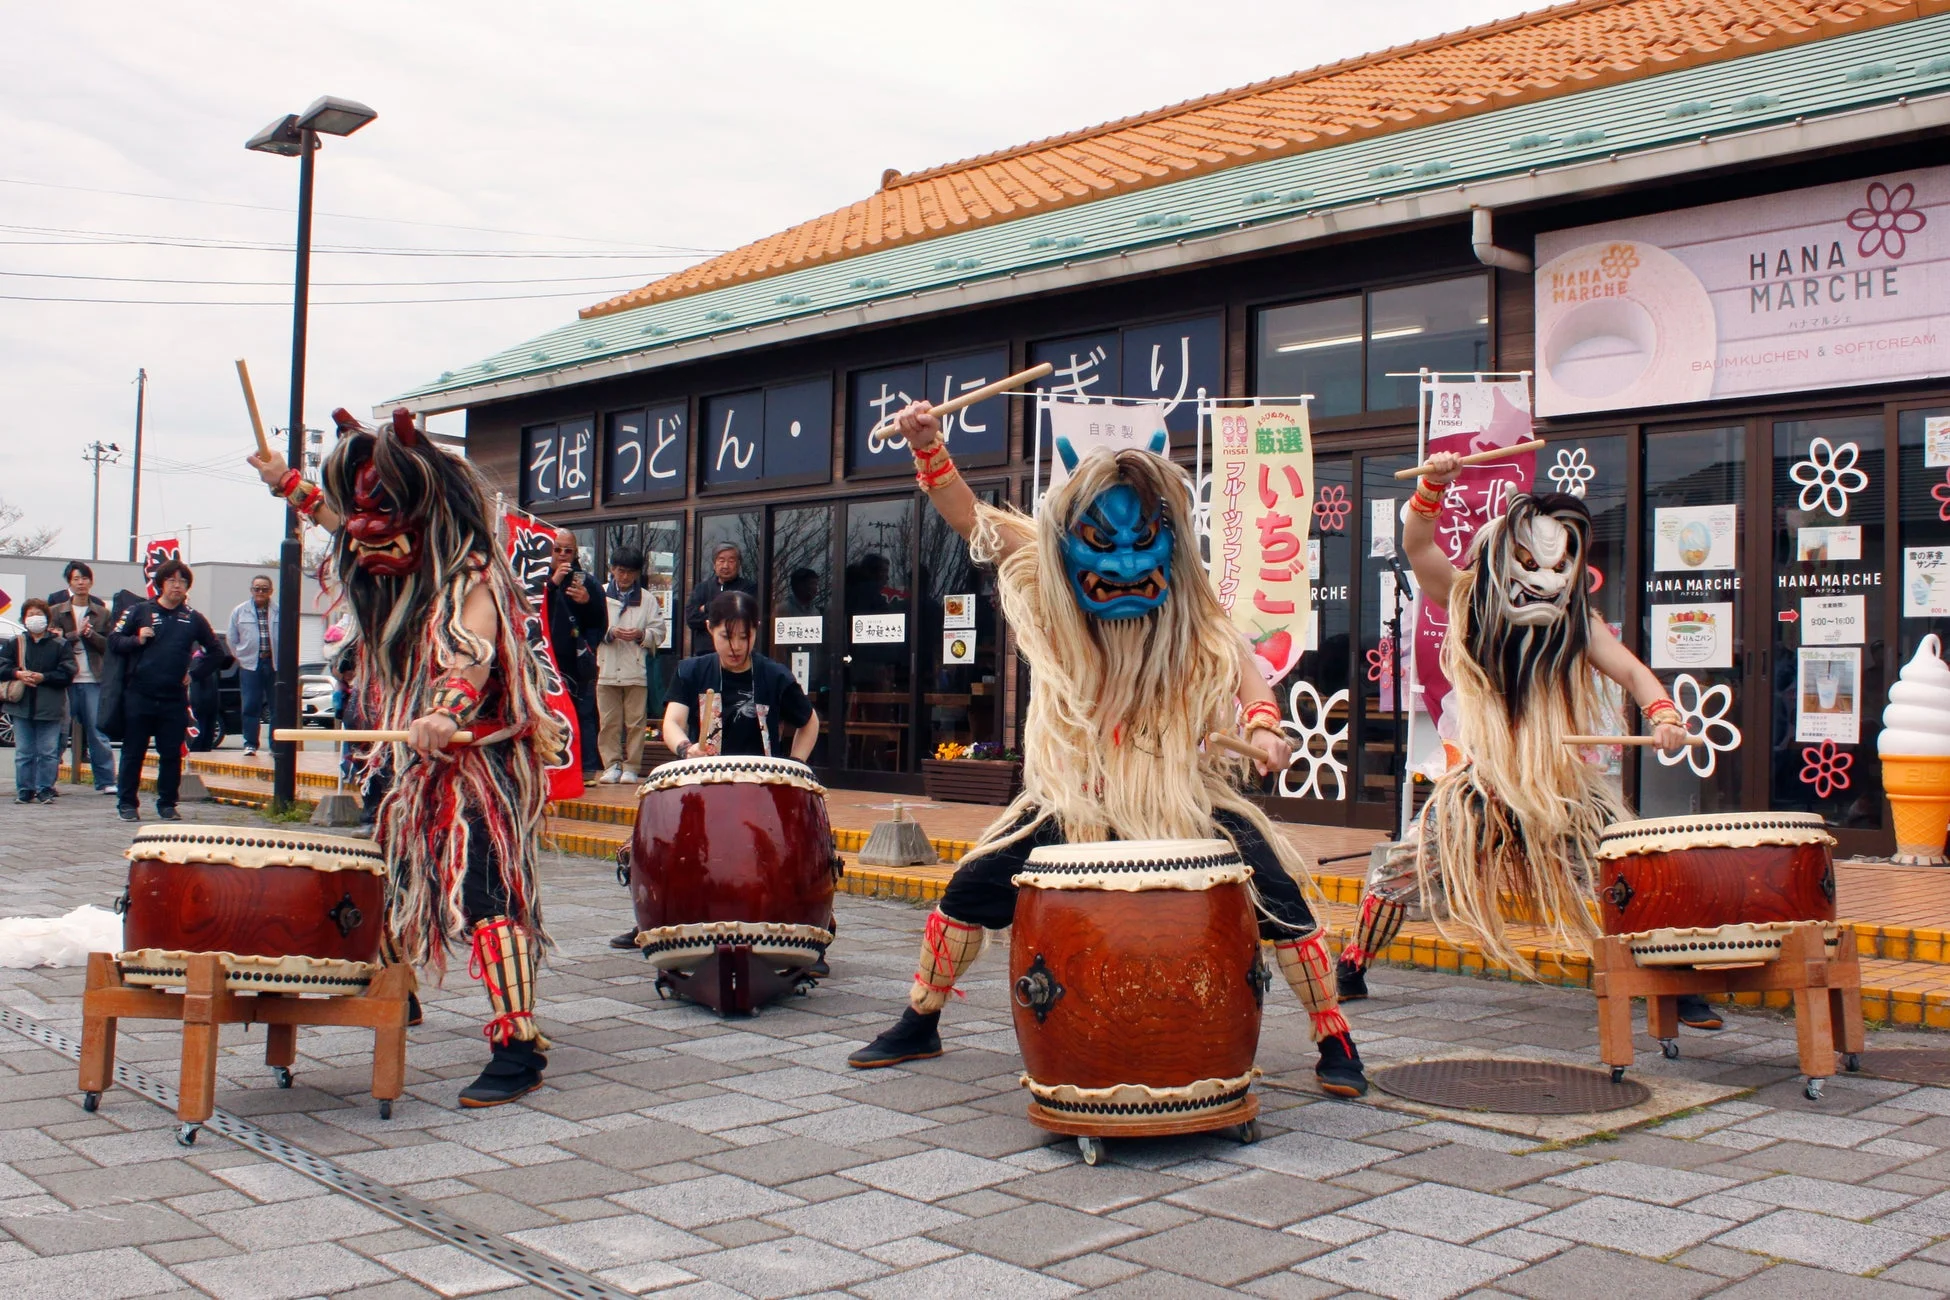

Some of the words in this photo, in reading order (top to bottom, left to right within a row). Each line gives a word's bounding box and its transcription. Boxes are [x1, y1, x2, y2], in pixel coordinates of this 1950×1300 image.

[1750, 241, 1846, 281] HANA
[1552, 268, 1602, 289] HANA
[1553, 280, 1628, 304] MARCHE
[1750, 267, 1899, 314] MARCHE
[1788, 315, 1852, 330] ハナマルシェ
[1691, 348, 1810, 372] BAUMKUCHEN
[1817, 346, 1826, 357] &
[1834, 334, 1937, 356] SOFTCREAM
[1089, 423, 1134, 440] 自家製
[1438, 419, 1463, 427] NISSEI
[1255, 426, 1304, 455] 厳選
[1223, 448, 1249, 456] NISSEI
[1440, 480, 1474, 569] あず
[1252, 462, 1305, 615] いちご
[1646, 579, 1682, 593] HANA
[1686, 577, 1741, 591] MARCHE
[1778, 575, 1818, 588] HANA
[1821, 573, 1882, 587] MARCHE
